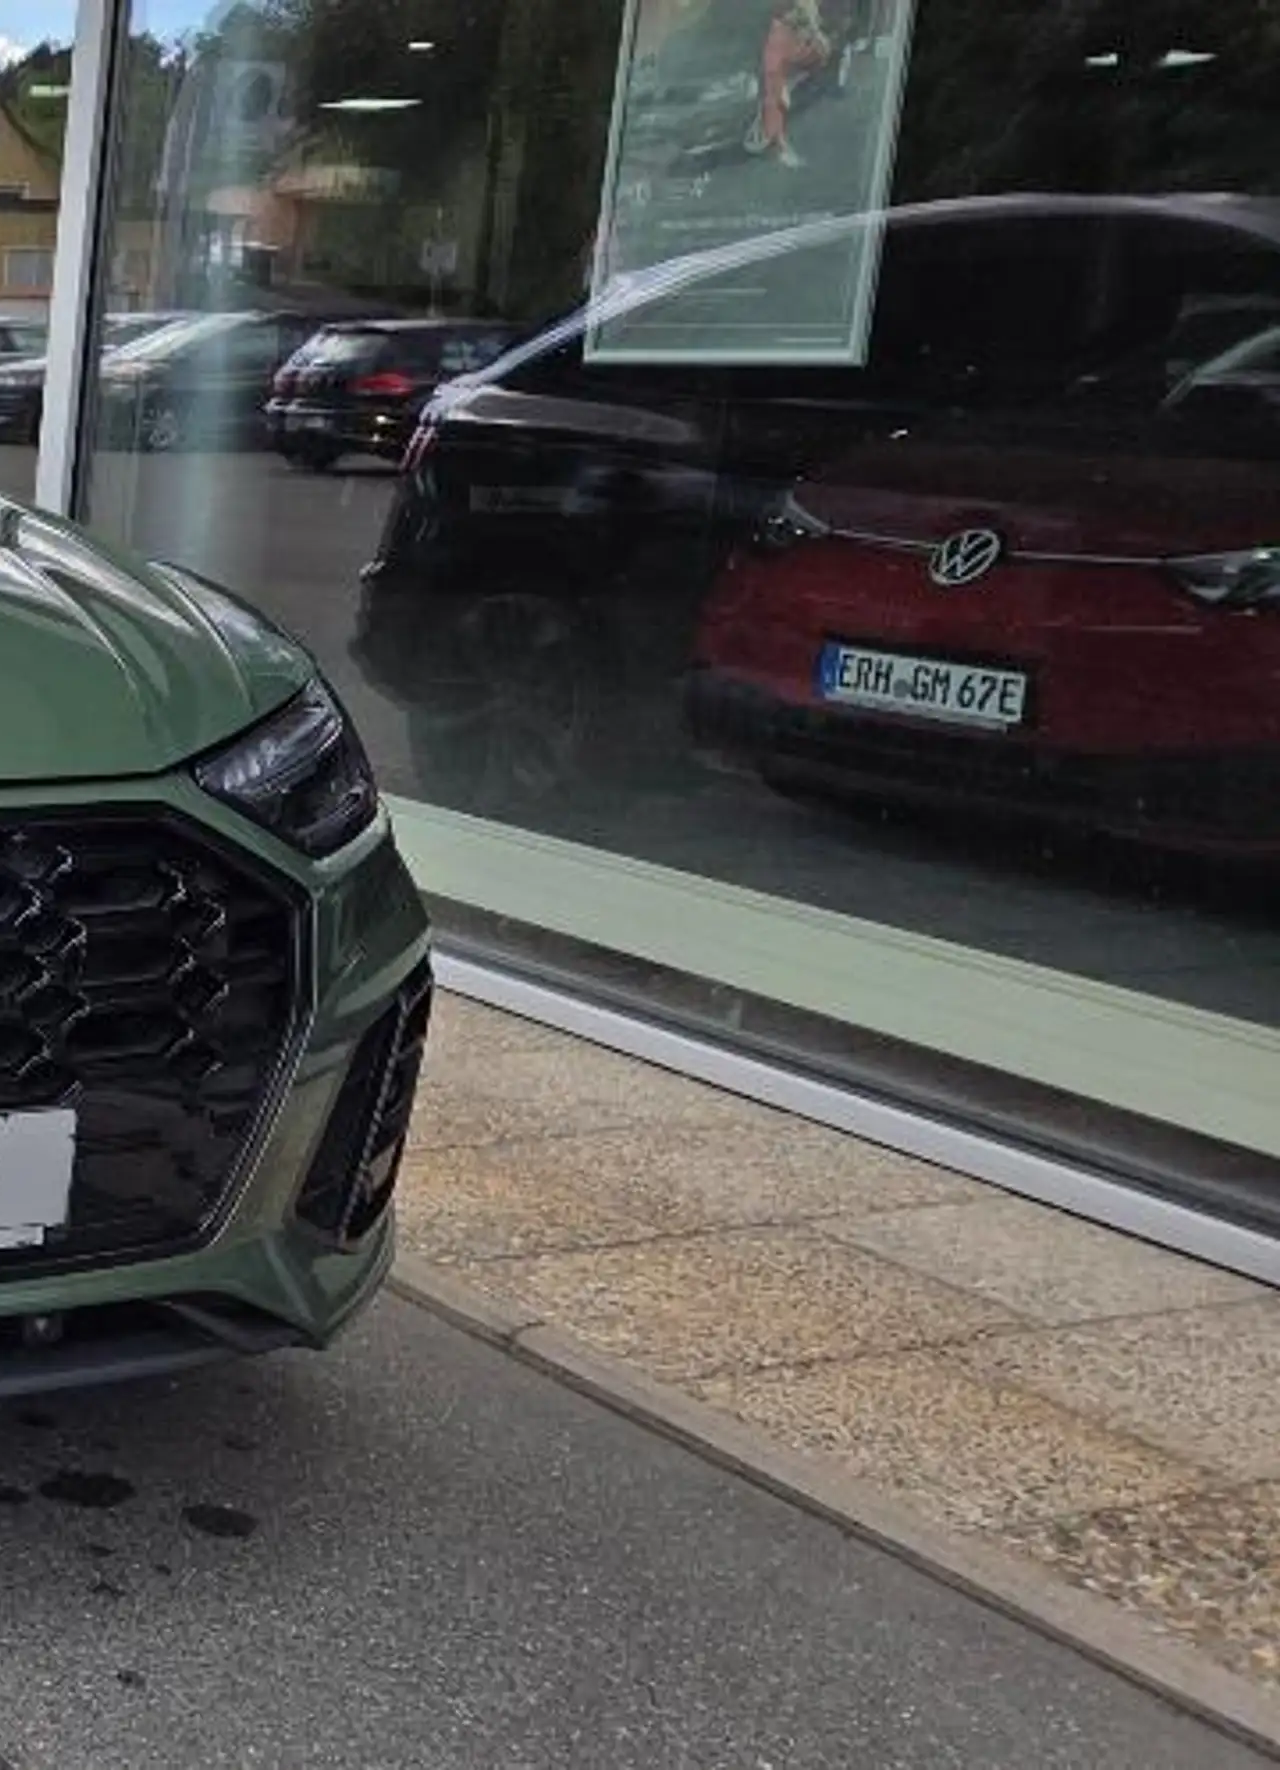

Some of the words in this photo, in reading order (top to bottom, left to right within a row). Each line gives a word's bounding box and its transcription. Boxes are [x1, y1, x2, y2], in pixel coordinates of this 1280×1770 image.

[838, 654, 894, 696] ERH
[910, 664, 951, 705] GM
[956, 673, 1021, 716] 67E
